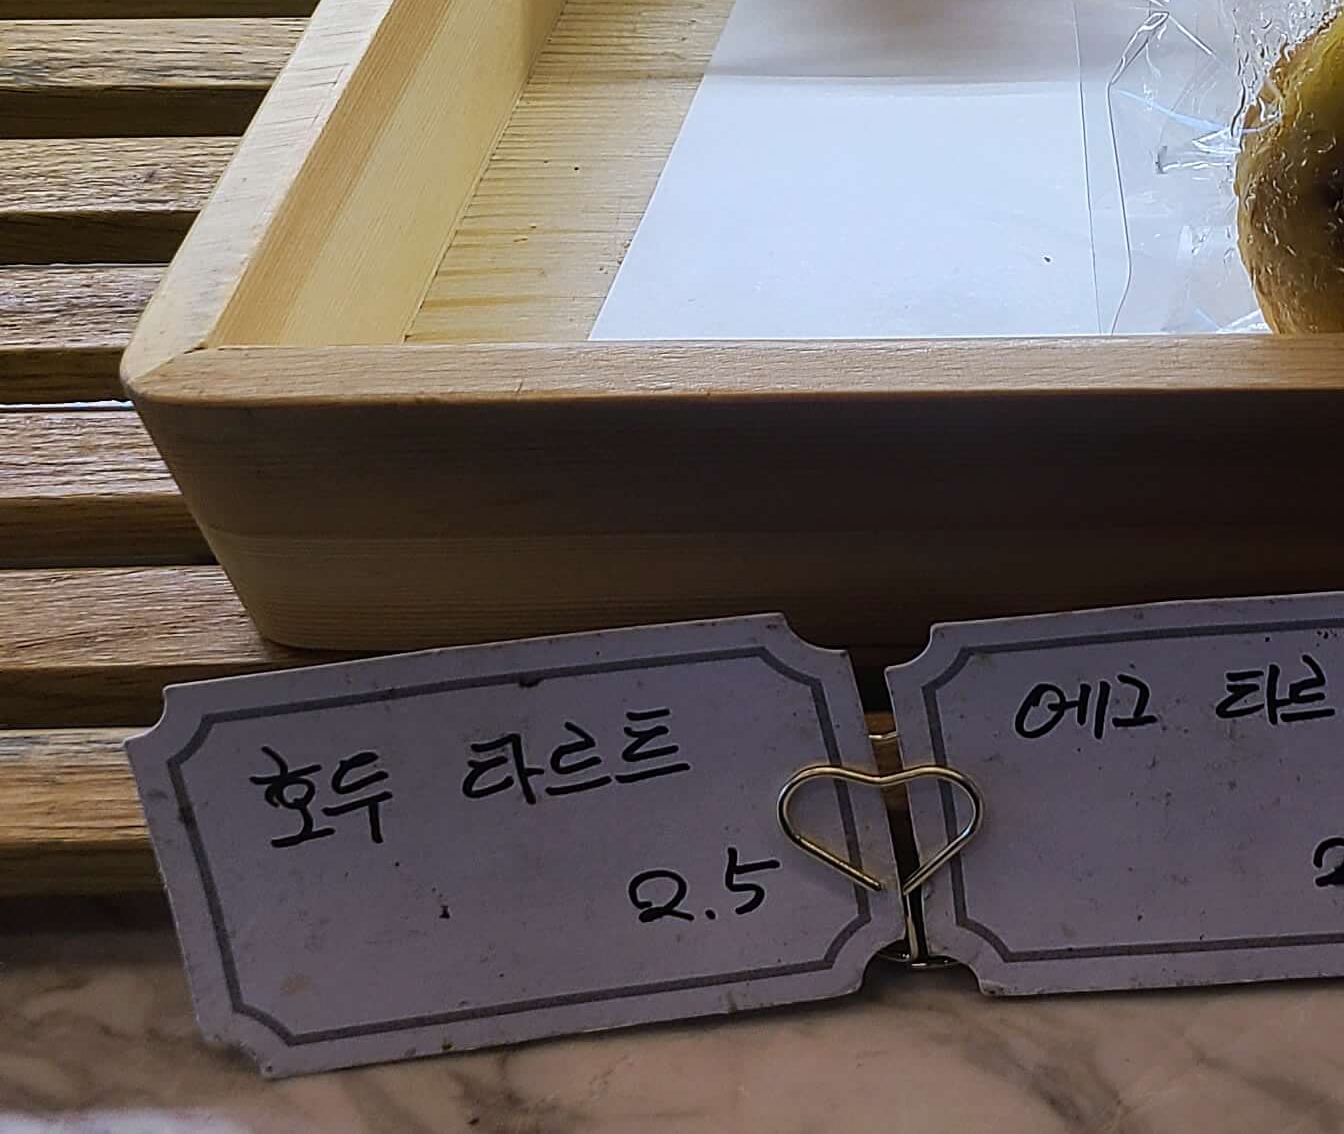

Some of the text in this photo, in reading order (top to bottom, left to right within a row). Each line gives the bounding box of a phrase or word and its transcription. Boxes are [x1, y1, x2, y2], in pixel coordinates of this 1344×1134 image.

[1013, 672, 1160, 740] 에그
[249, 707, 691, 849] 호두 타르트
[627, 846, 781, 925] 2.5
